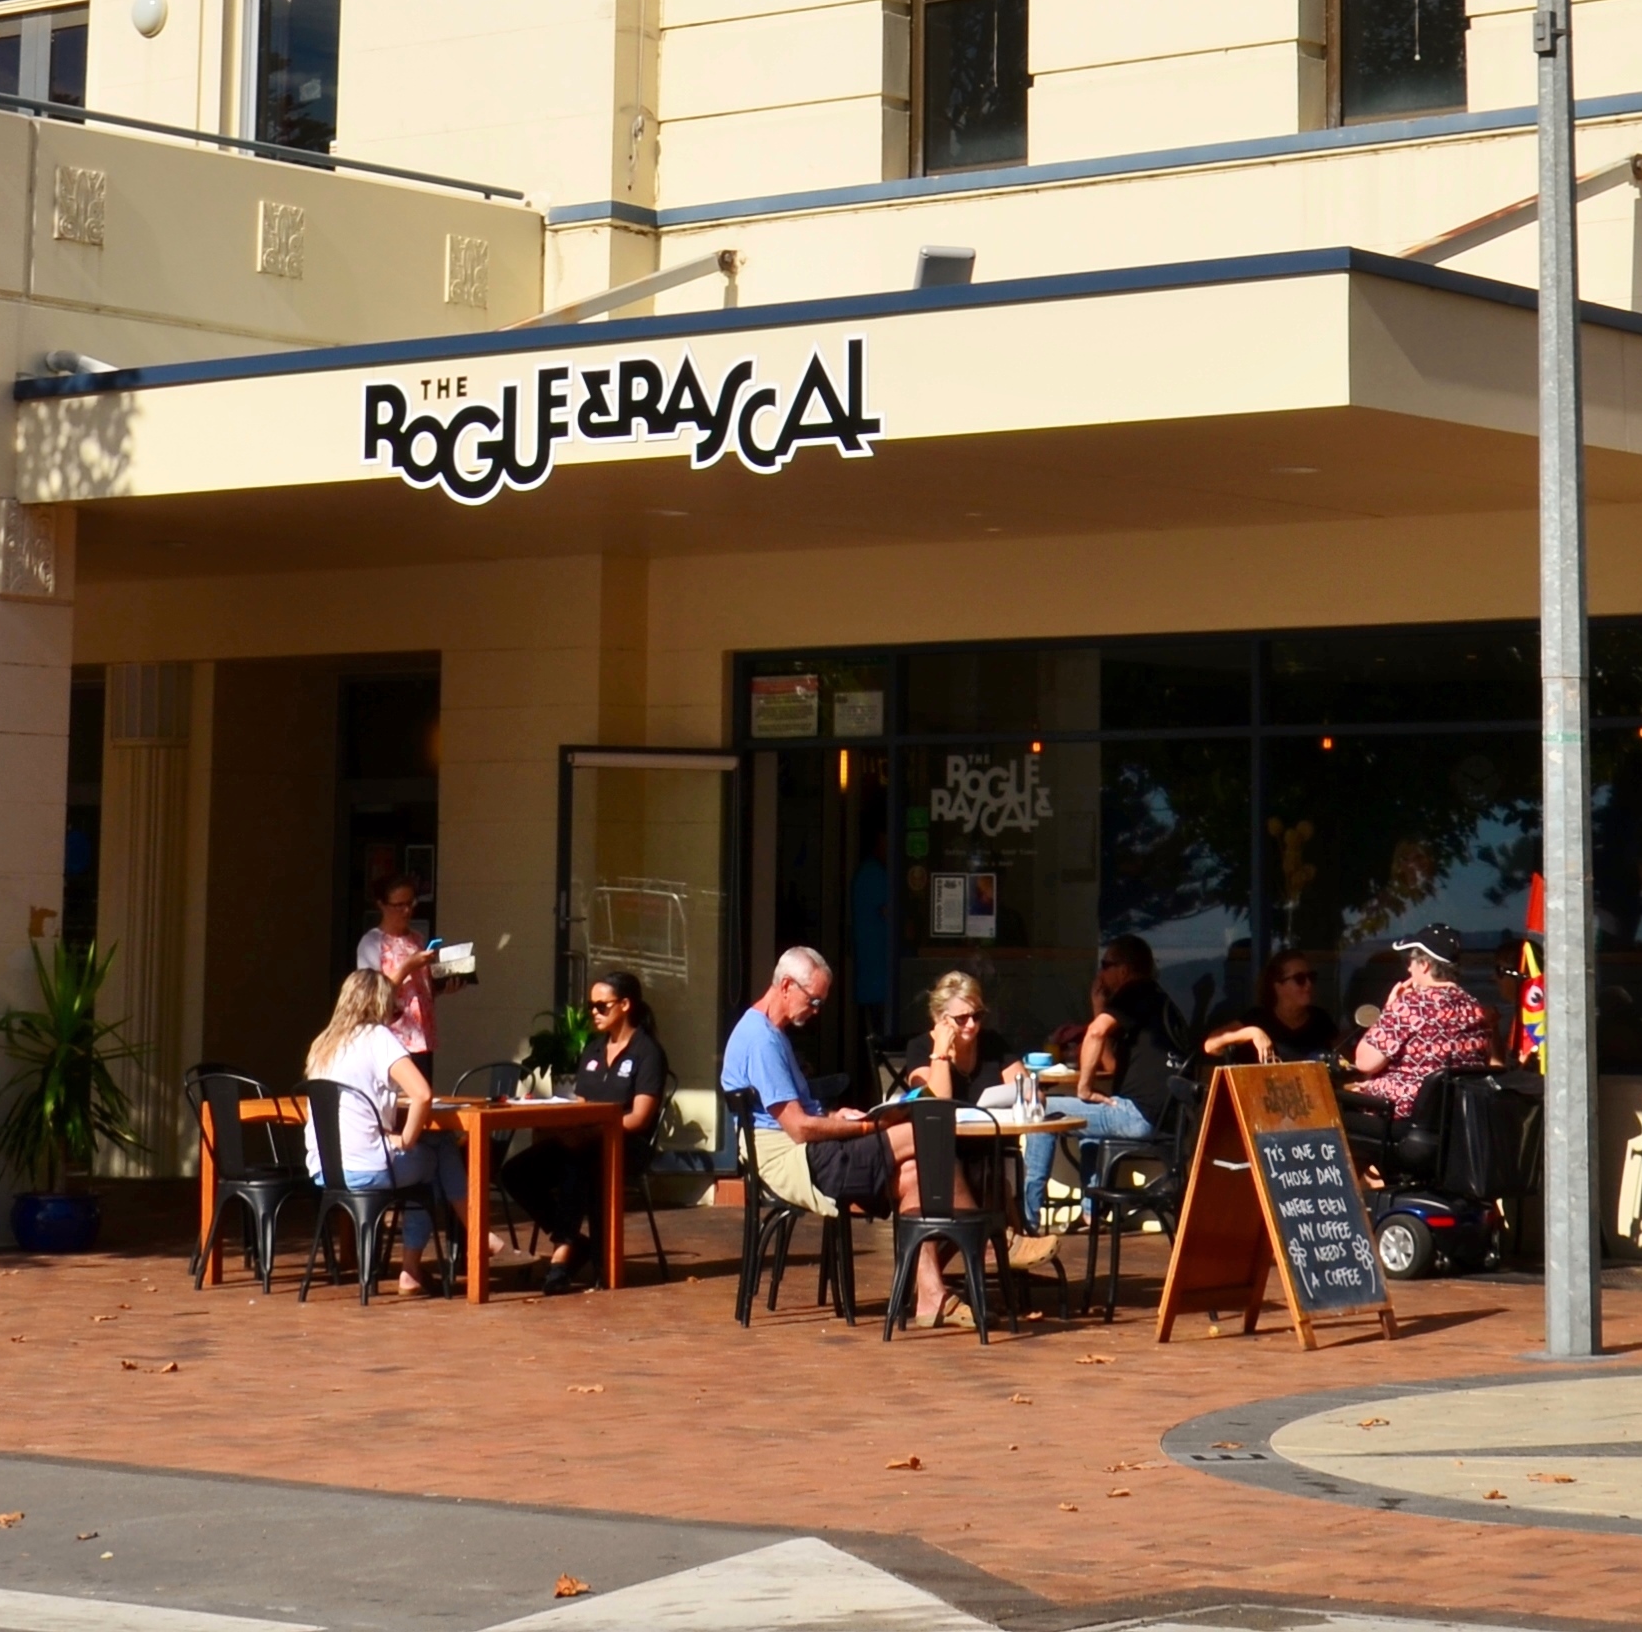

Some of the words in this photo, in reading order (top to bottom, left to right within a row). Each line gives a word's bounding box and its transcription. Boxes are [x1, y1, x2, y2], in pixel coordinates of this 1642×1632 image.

[419, 376, 470, 401] THE
[1291, 1143, 1316, 1161] ONE
[1320, 1143, 1336, 1160] OF
[1278, 1168, 1313, 1189] THOSE
[1278, 1197, 1315, 1218] WHERE
[1317, 1196, 1347, 1216] EVEN
[1297, 1221, 1315, 1242] MY
[1316, 1220, 1352, 1240] COFFEE
[1313, 1241, 1347, 1262] NEEDS
[1311, 1271, 1321, 1289] A
[1324, 1266, 1362, 1287] COFFEE
